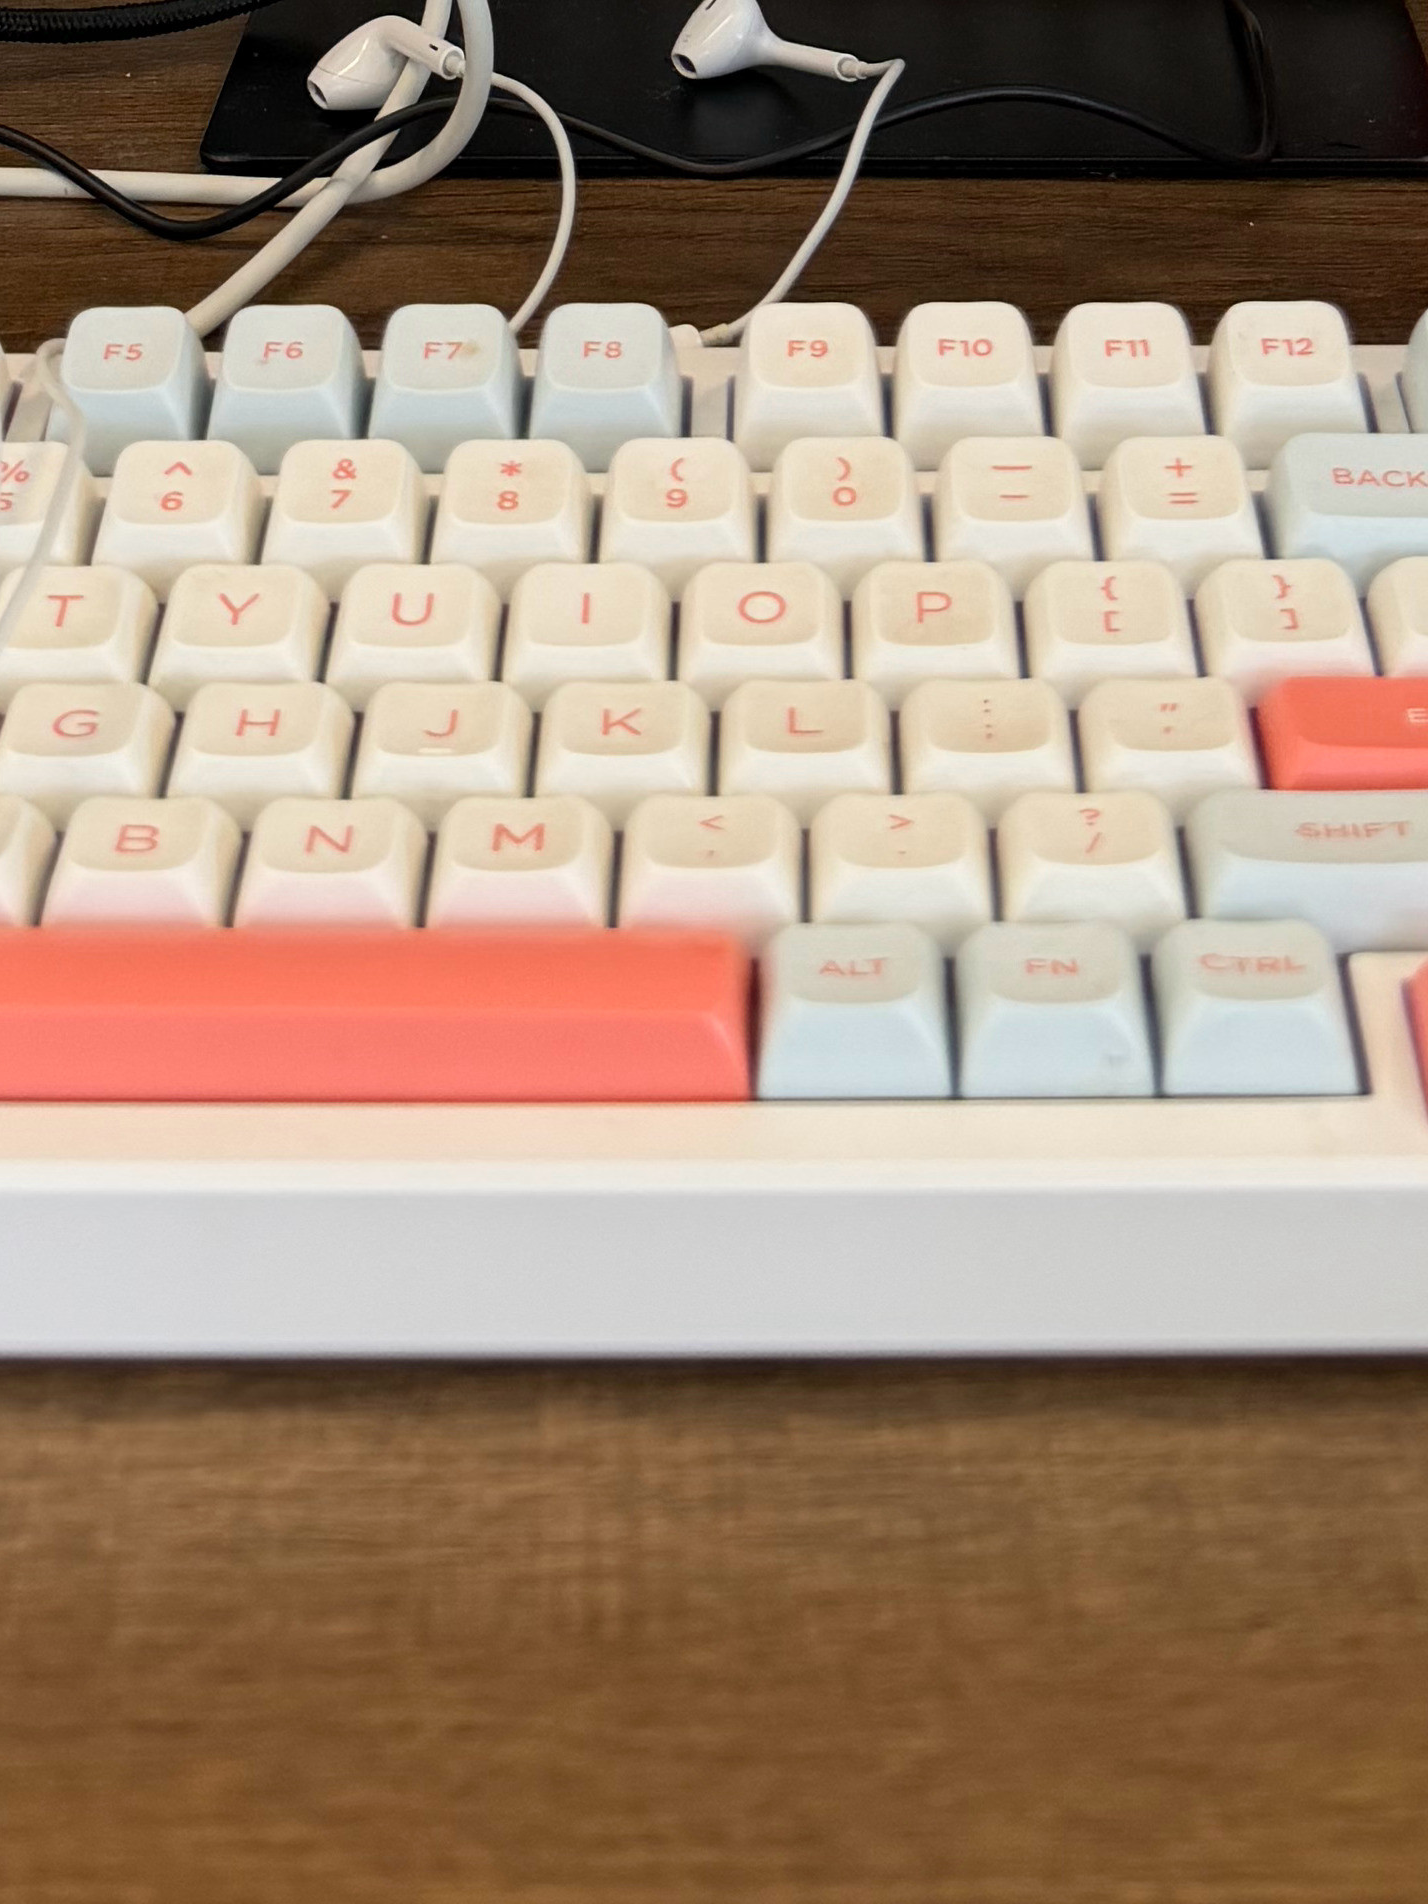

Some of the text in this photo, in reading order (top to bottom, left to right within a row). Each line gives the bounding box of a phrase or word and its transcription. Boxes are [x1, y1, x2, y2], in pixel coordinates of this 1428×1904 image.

[104, 344, 143, 361] F5
[262, 342, 304, 360] F6
[424, 342, 463, 360] F7
[582, 342, 623, 360] F8
[786, 340, 829, 358] F9
[937, 339, 993, 358] F10
[1103, 338, 1152, 359] F11
[1260, 338, 1313, 356] F12
[915, 592, 952, 624] P
[602, 708, 642, 736] K
[1025, 958, 1080, 977] FN
